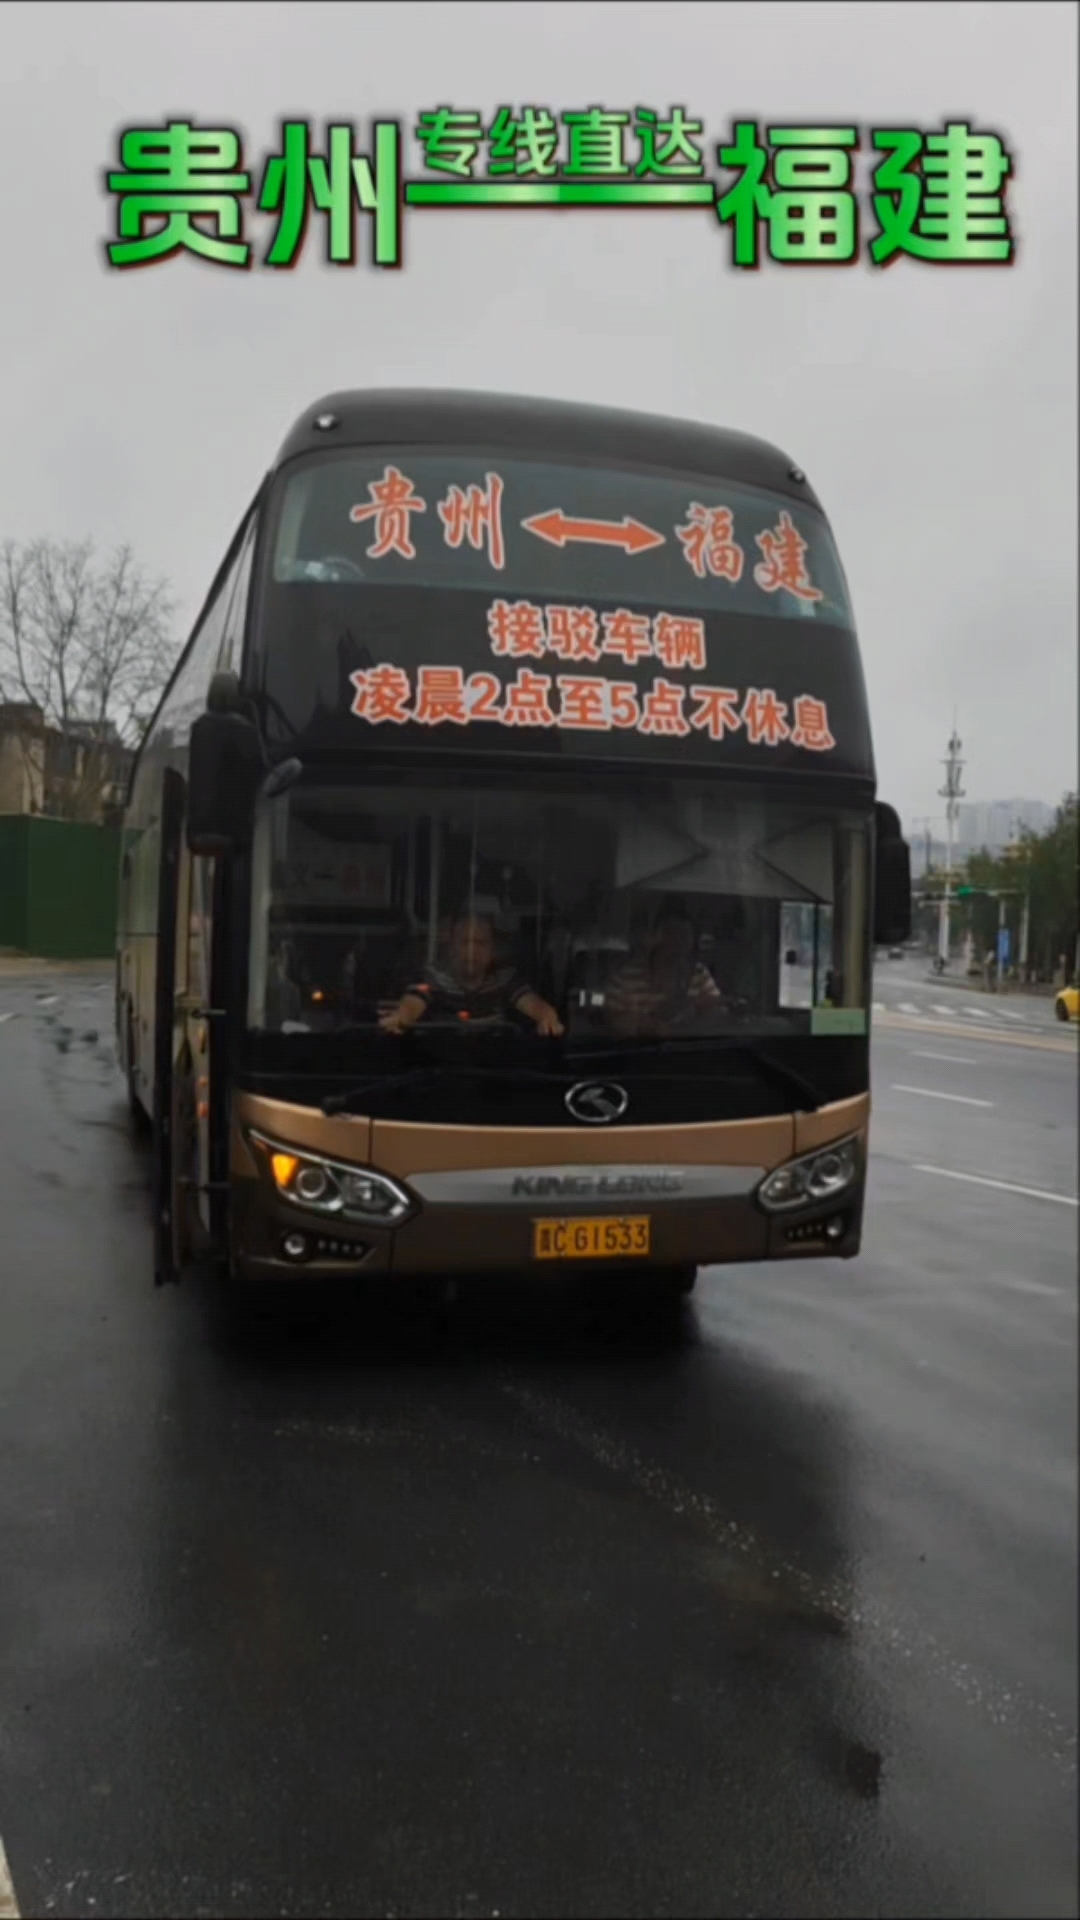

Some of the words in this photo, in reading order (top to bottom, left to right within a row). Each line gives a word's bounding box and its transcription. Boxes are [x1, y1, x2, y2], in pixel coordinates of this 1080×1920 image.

[350, 465, 505, 570] 贵州
[674, 501, 824, 601] 福建
[488, 599, 706, 670] 接驳车辆
[349, 664, 836, 751] 凌晨2点至5点不休息
